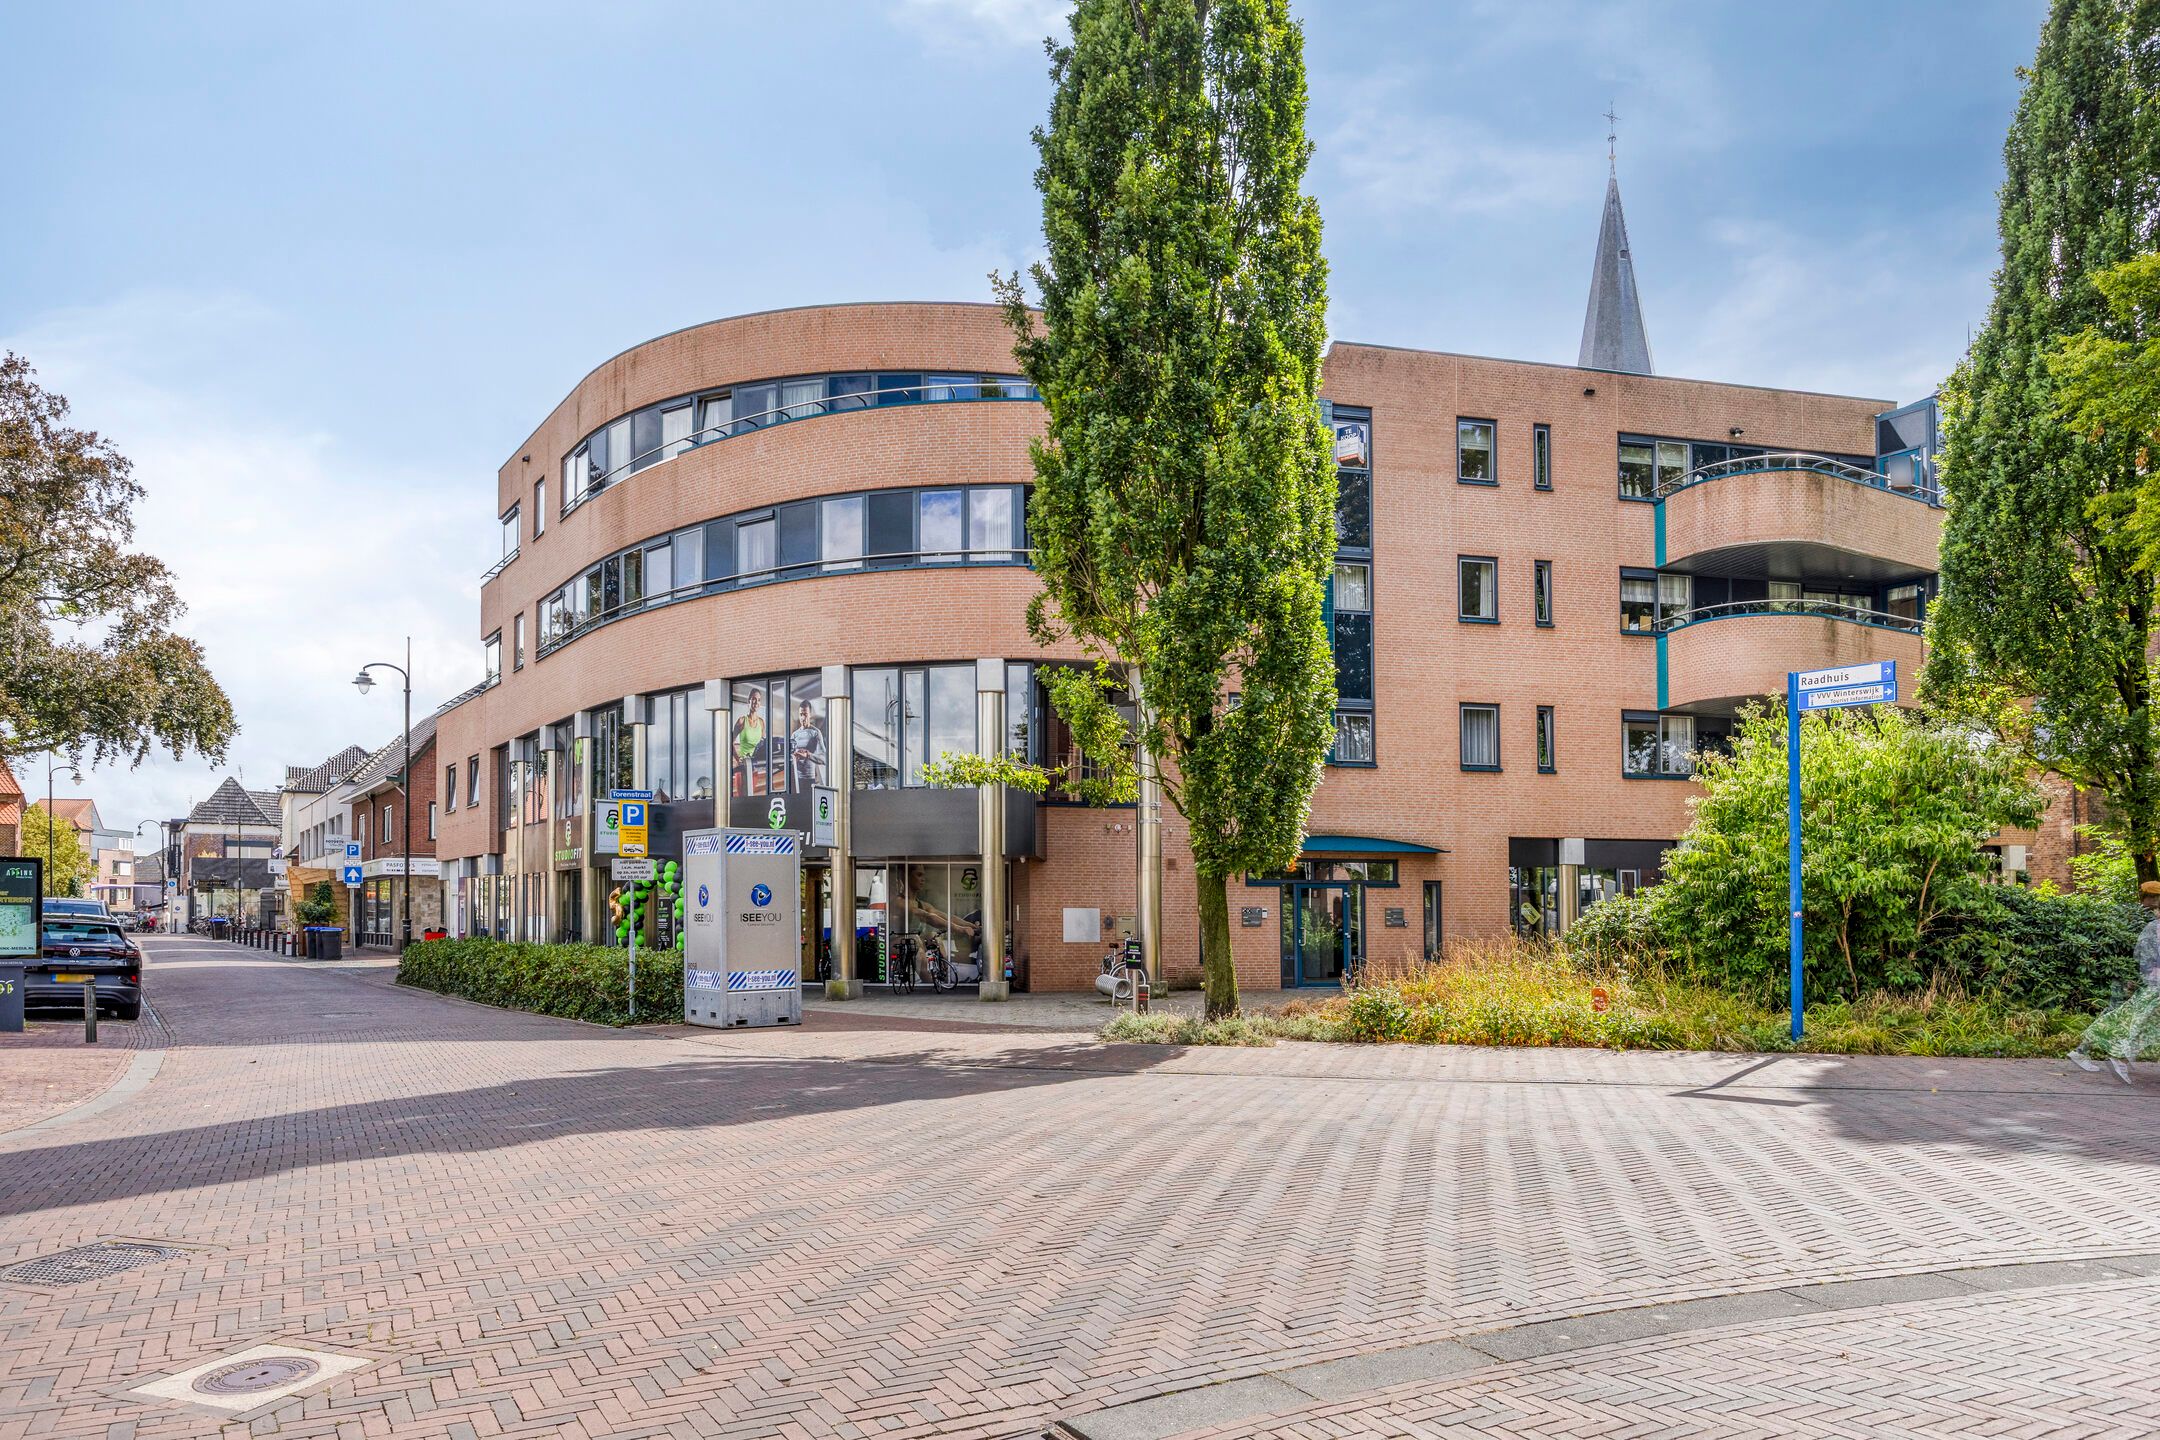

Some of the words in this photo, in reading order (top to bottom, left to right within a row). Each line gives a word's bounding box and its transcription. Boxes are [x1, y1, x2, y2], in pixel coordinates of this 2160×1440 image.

[1801, 672, 1849, 686] Raadhuis
[1817, 691, 1831, 699] VVV
[1833, 686, 1880, 698] Winterswijk
[627, 806, 640, 823] P
[349, 846, 357, 854] P
[555, 848, 582, 861] STUDIOFIT
[740, 912, 782, 922] ISEEYOU
